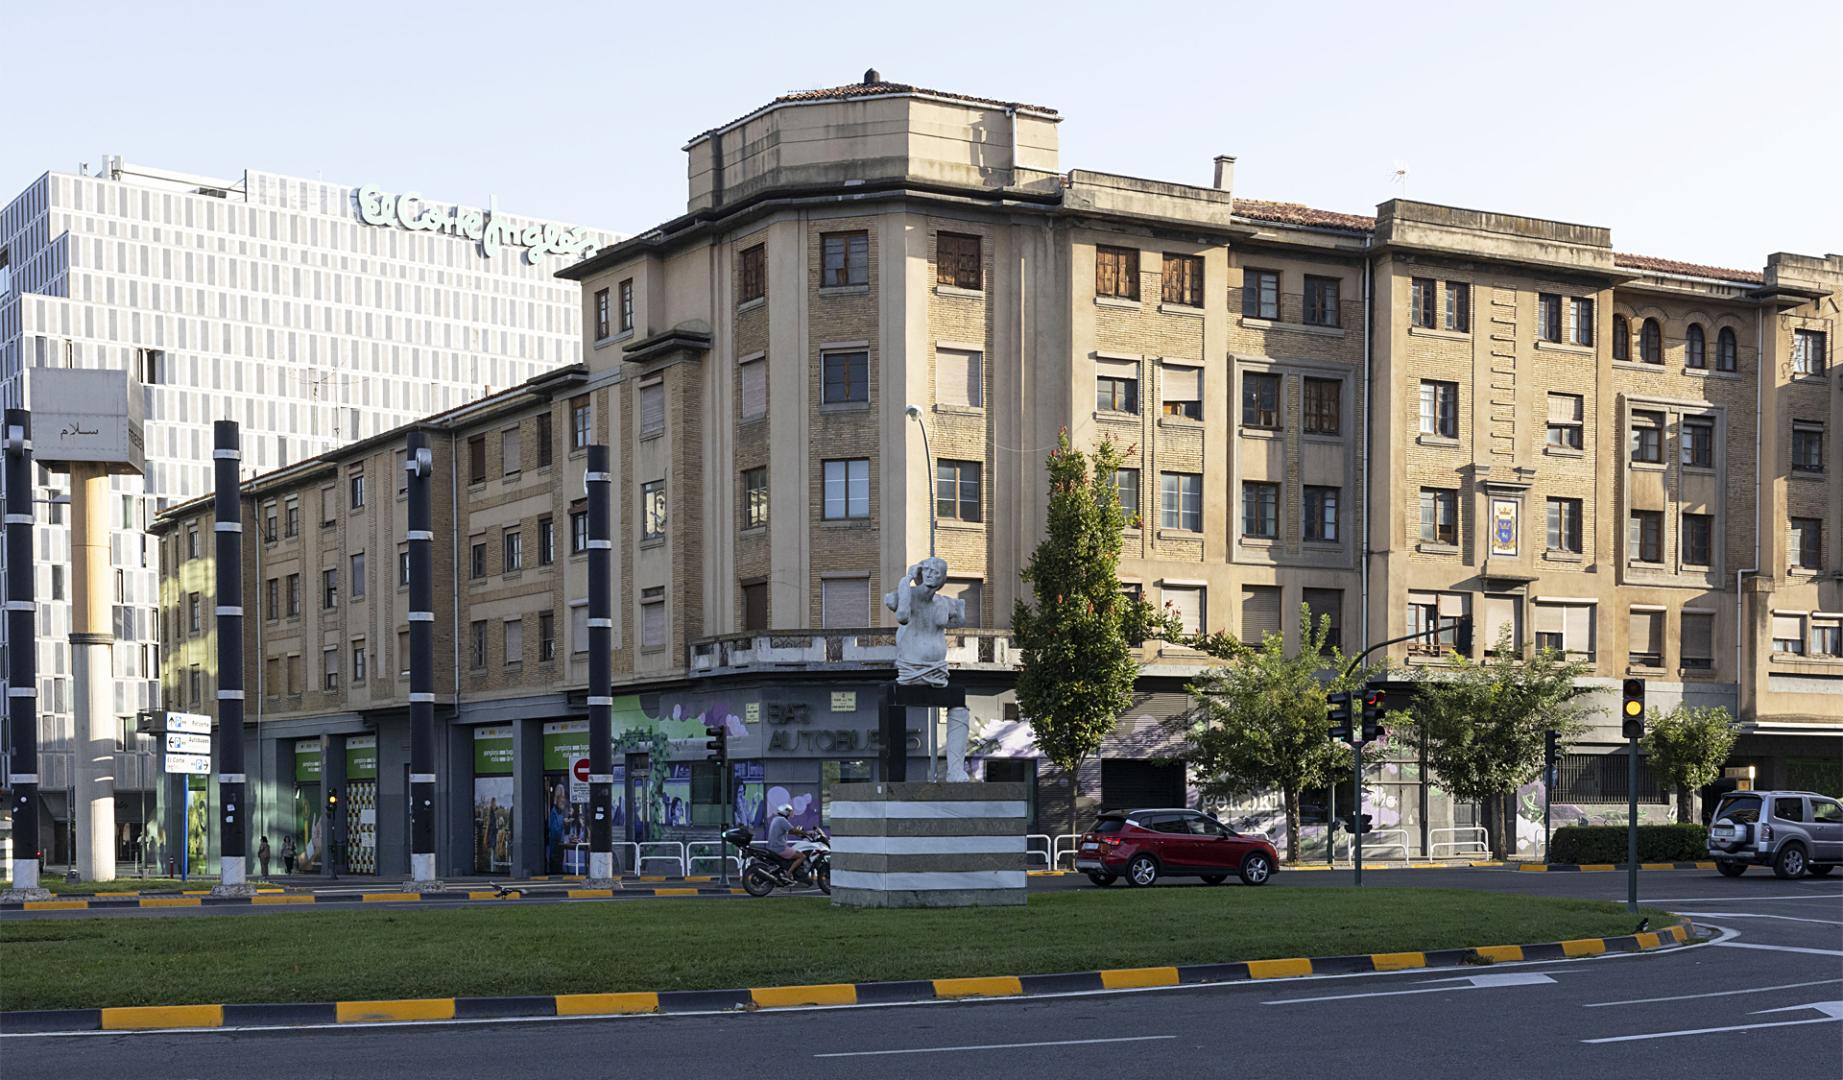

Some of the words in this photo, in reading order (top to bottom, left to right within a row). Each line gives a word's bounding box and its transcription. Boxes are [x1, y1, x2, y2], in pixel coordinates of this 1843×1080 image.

[358, 183, 397, 227] El
[397, 191, 483, 240] Corte
[60, 421, 99, 441] سلام
[768, 703, 811, 725] BAR
[768, 729, 922, 752] AUTOBUSS
